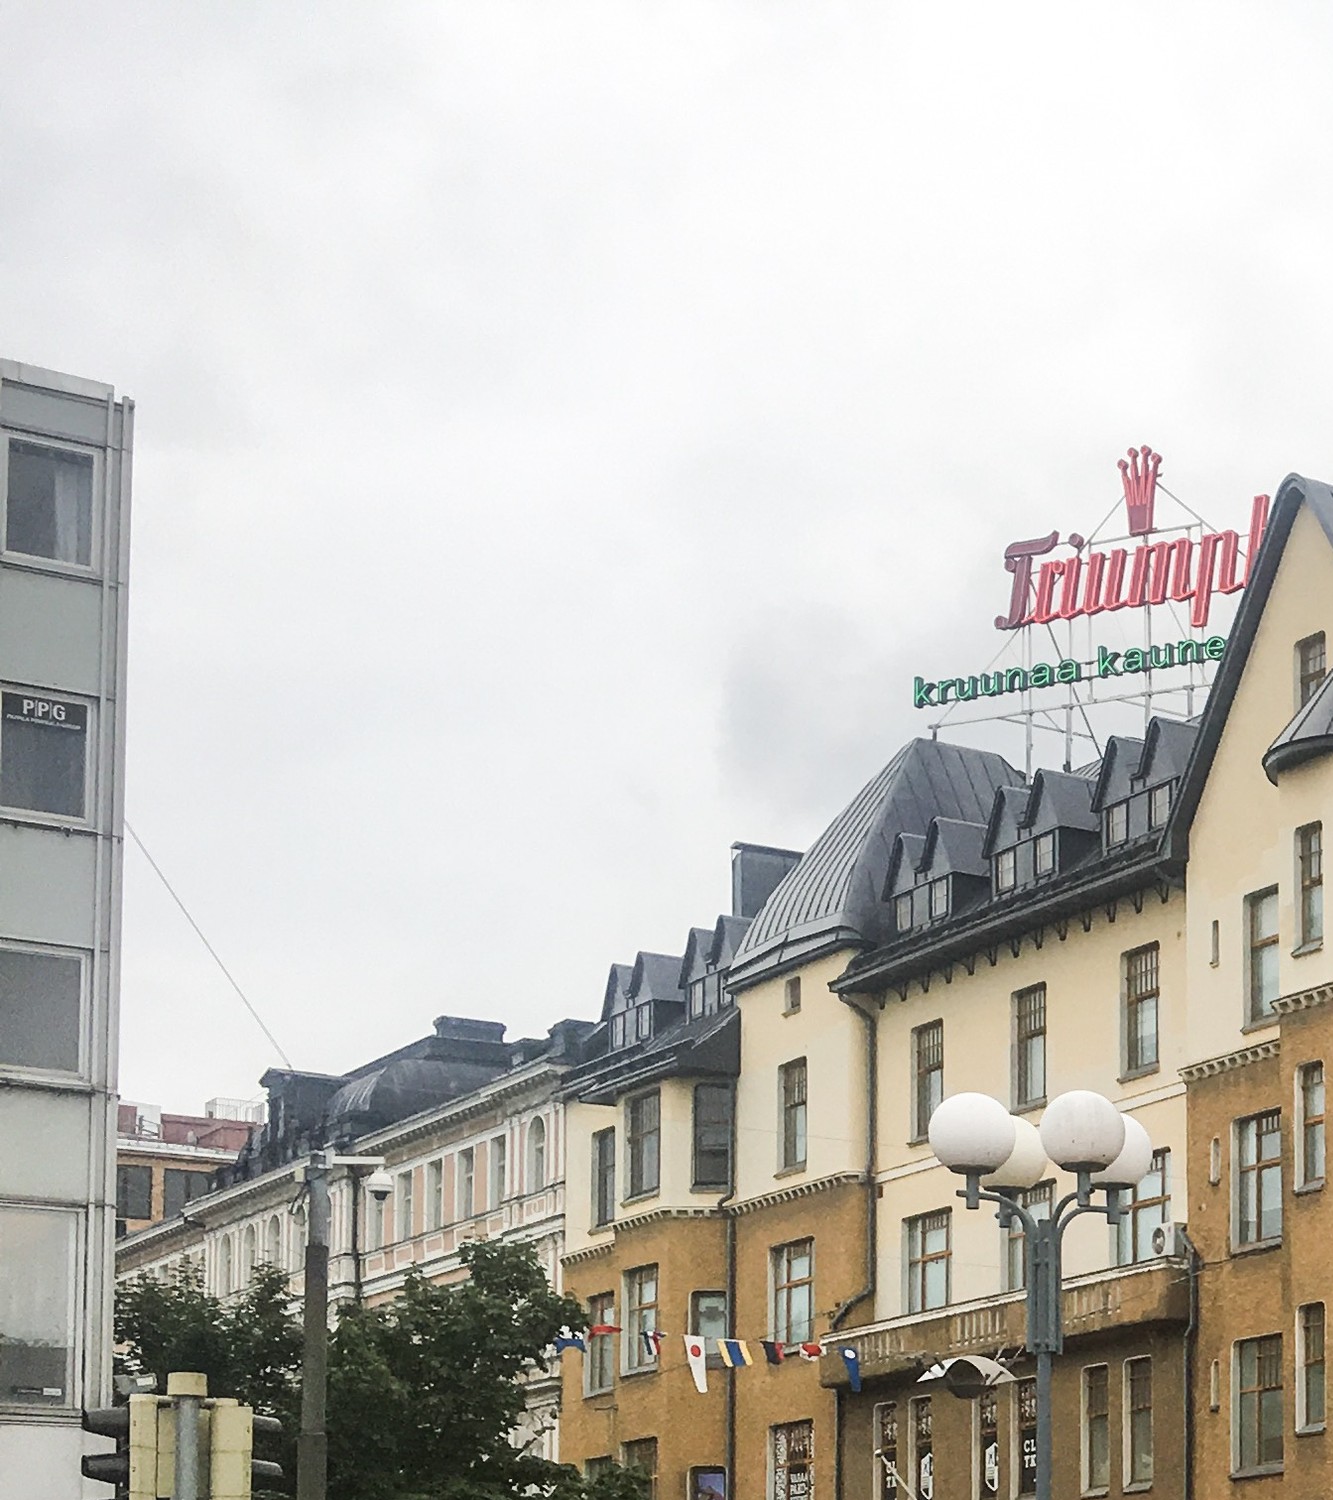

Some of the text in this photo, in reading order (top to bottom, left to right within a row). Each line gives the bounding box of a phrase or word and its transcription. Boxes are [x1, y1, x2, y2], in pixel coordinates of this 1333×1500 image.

[913, 634, 1229, 708] kruunaa kaune
[1023, 1439, 1036, 1454] CL
